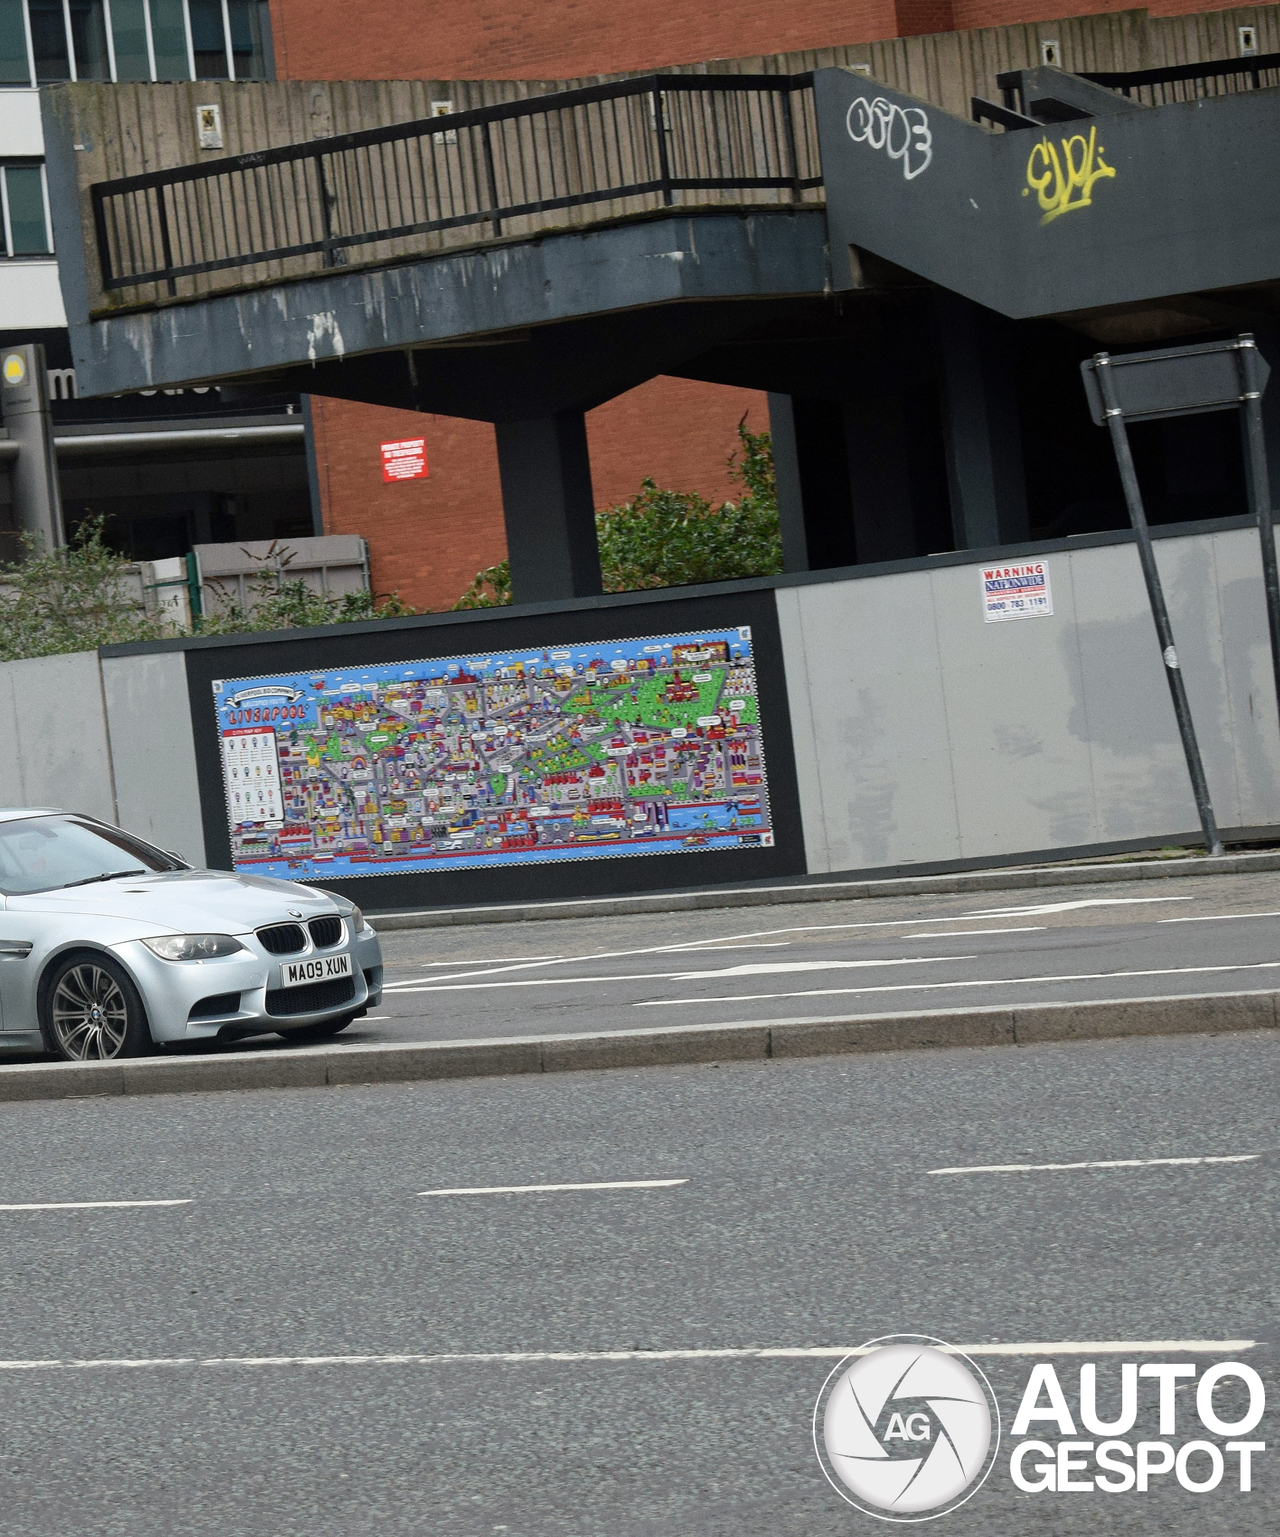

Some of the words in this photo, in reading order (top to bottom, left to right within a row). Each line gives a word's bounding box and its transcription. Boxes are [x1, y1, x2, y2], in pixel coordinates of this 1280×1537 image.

[983, 564, 1043, 580] WARNING
[985, 575, 1044, 591] NATIONWIDE
[987, 601, 1007, 611] 0800
[1010, 599, 1025, 608] 783
[1029, 597, 1047, 606] 1191
[229, 704, 306, 725] LIVERPOOL
[288, 961, 324, 982] MA09
[325, 956, 348, 976] XUN
